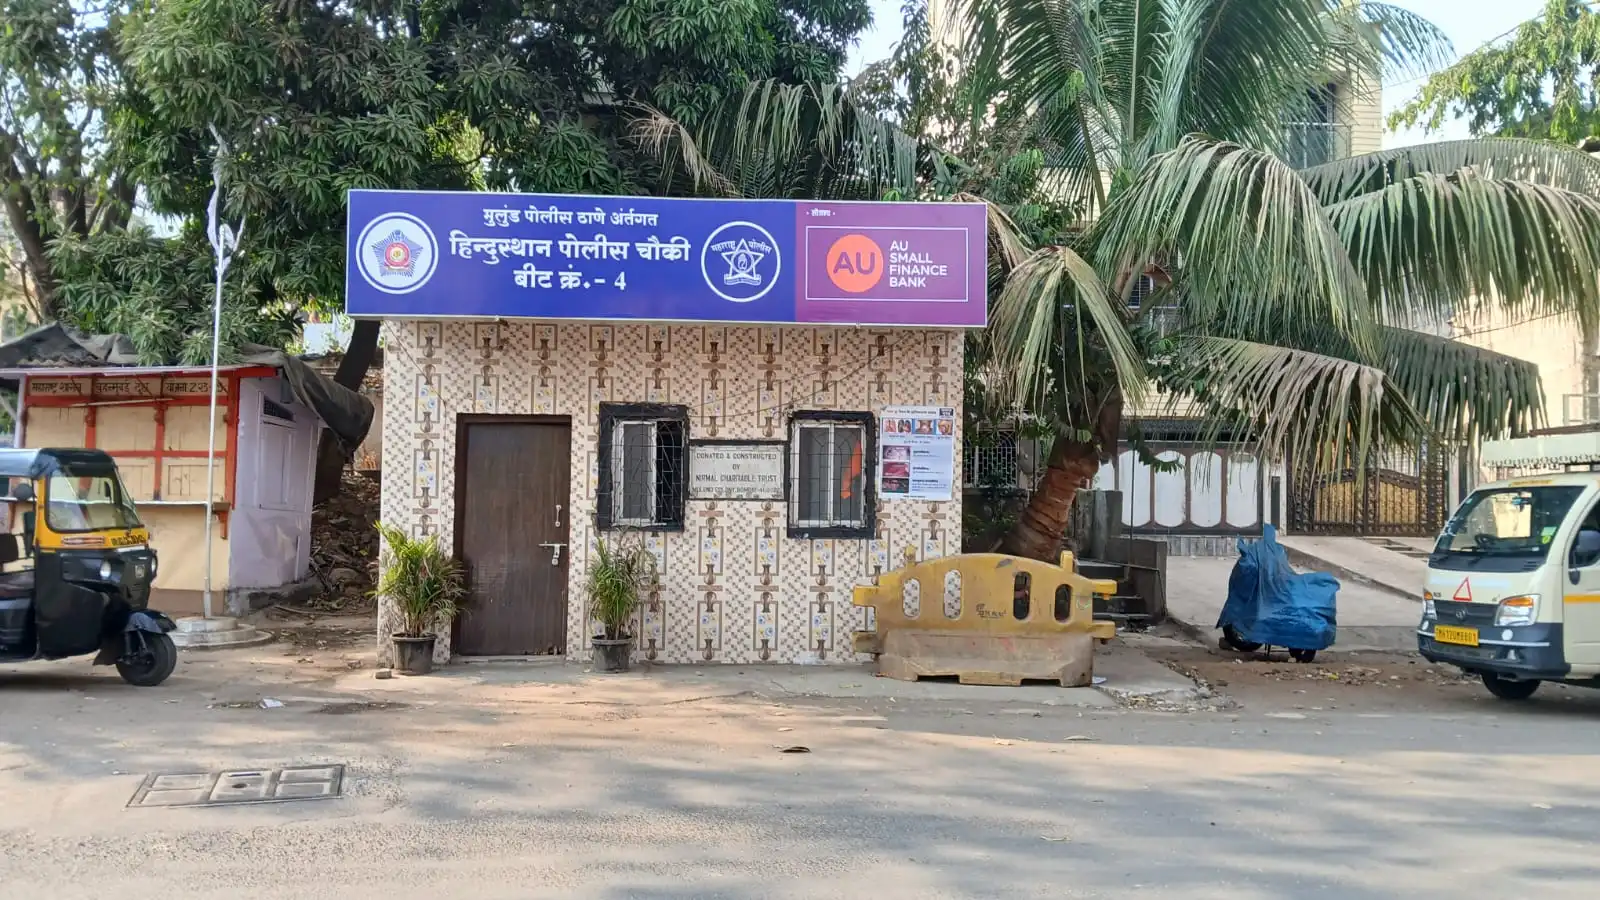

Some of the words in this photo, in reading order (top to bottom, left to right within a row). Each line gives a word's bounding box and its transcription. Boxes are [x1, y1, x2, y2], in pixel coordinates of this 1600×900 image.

[483, 204, 521, 227] मुलुंड
[524, 205, 574, 224] पोलीस
[576, 207, 606, 225] ठाणे
[449, 229, 553, 265] हिन्दुस्थान
[558, 233, 630, 260] पोलीस
[635, 235, 691, 261] चौकी
[889, 240, 909, 251] AU
[832, 251, 876, 275] AU
[889, 252, 933, 264] SMALL
[513, 262, 553, 289] बीट
[889, 264, 948, 276] FINANCE
[889, 276, 926, 288] BANK
